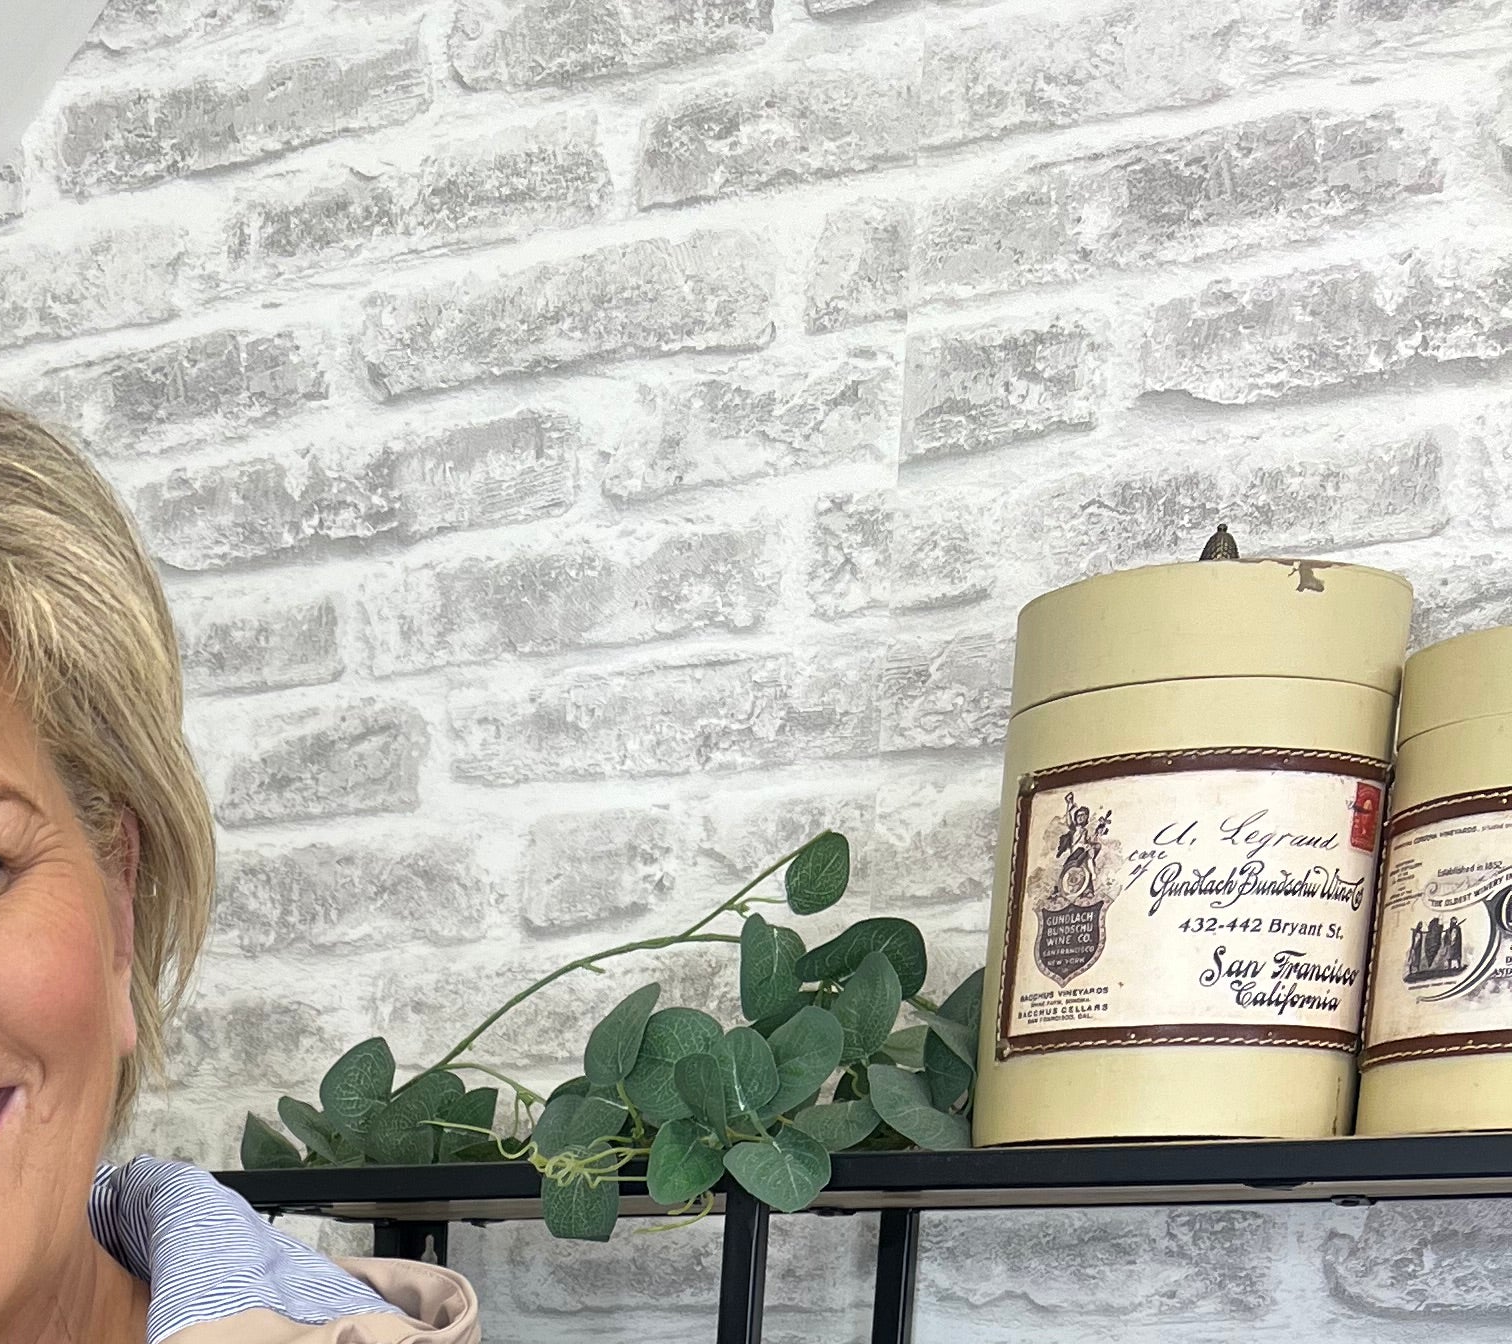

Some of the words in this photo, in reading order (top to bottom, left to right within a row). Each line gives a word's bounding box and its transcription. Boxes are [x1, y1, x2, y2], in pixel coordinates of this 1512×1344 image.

[1219, 808, 1339, 859] Legrand
[1046, 911, 1094, 927] GUNDLACH
[1047, 923, 1093, 937] BUNDSCHU
[1178, 917, 1263, 933] 432-442
[1268, 918, 1322, 938] Bryant
[1326, 924, 1344, 940] St.
[1046, 934, 1072, 947] WINE
[1199, 945, 1266, 987] San
[1270, 949, 1361, 987] Francisco
[1020, 991, 1055, 1003] BACCHUS
[1057, 986, 1109, 998] VINEYARDS
[1229, 979, 1342, 1016] California
[1017, 1006, 1058, 1020] BACCHUS
[1060, 1003, 1109, 1015] CELLARS
